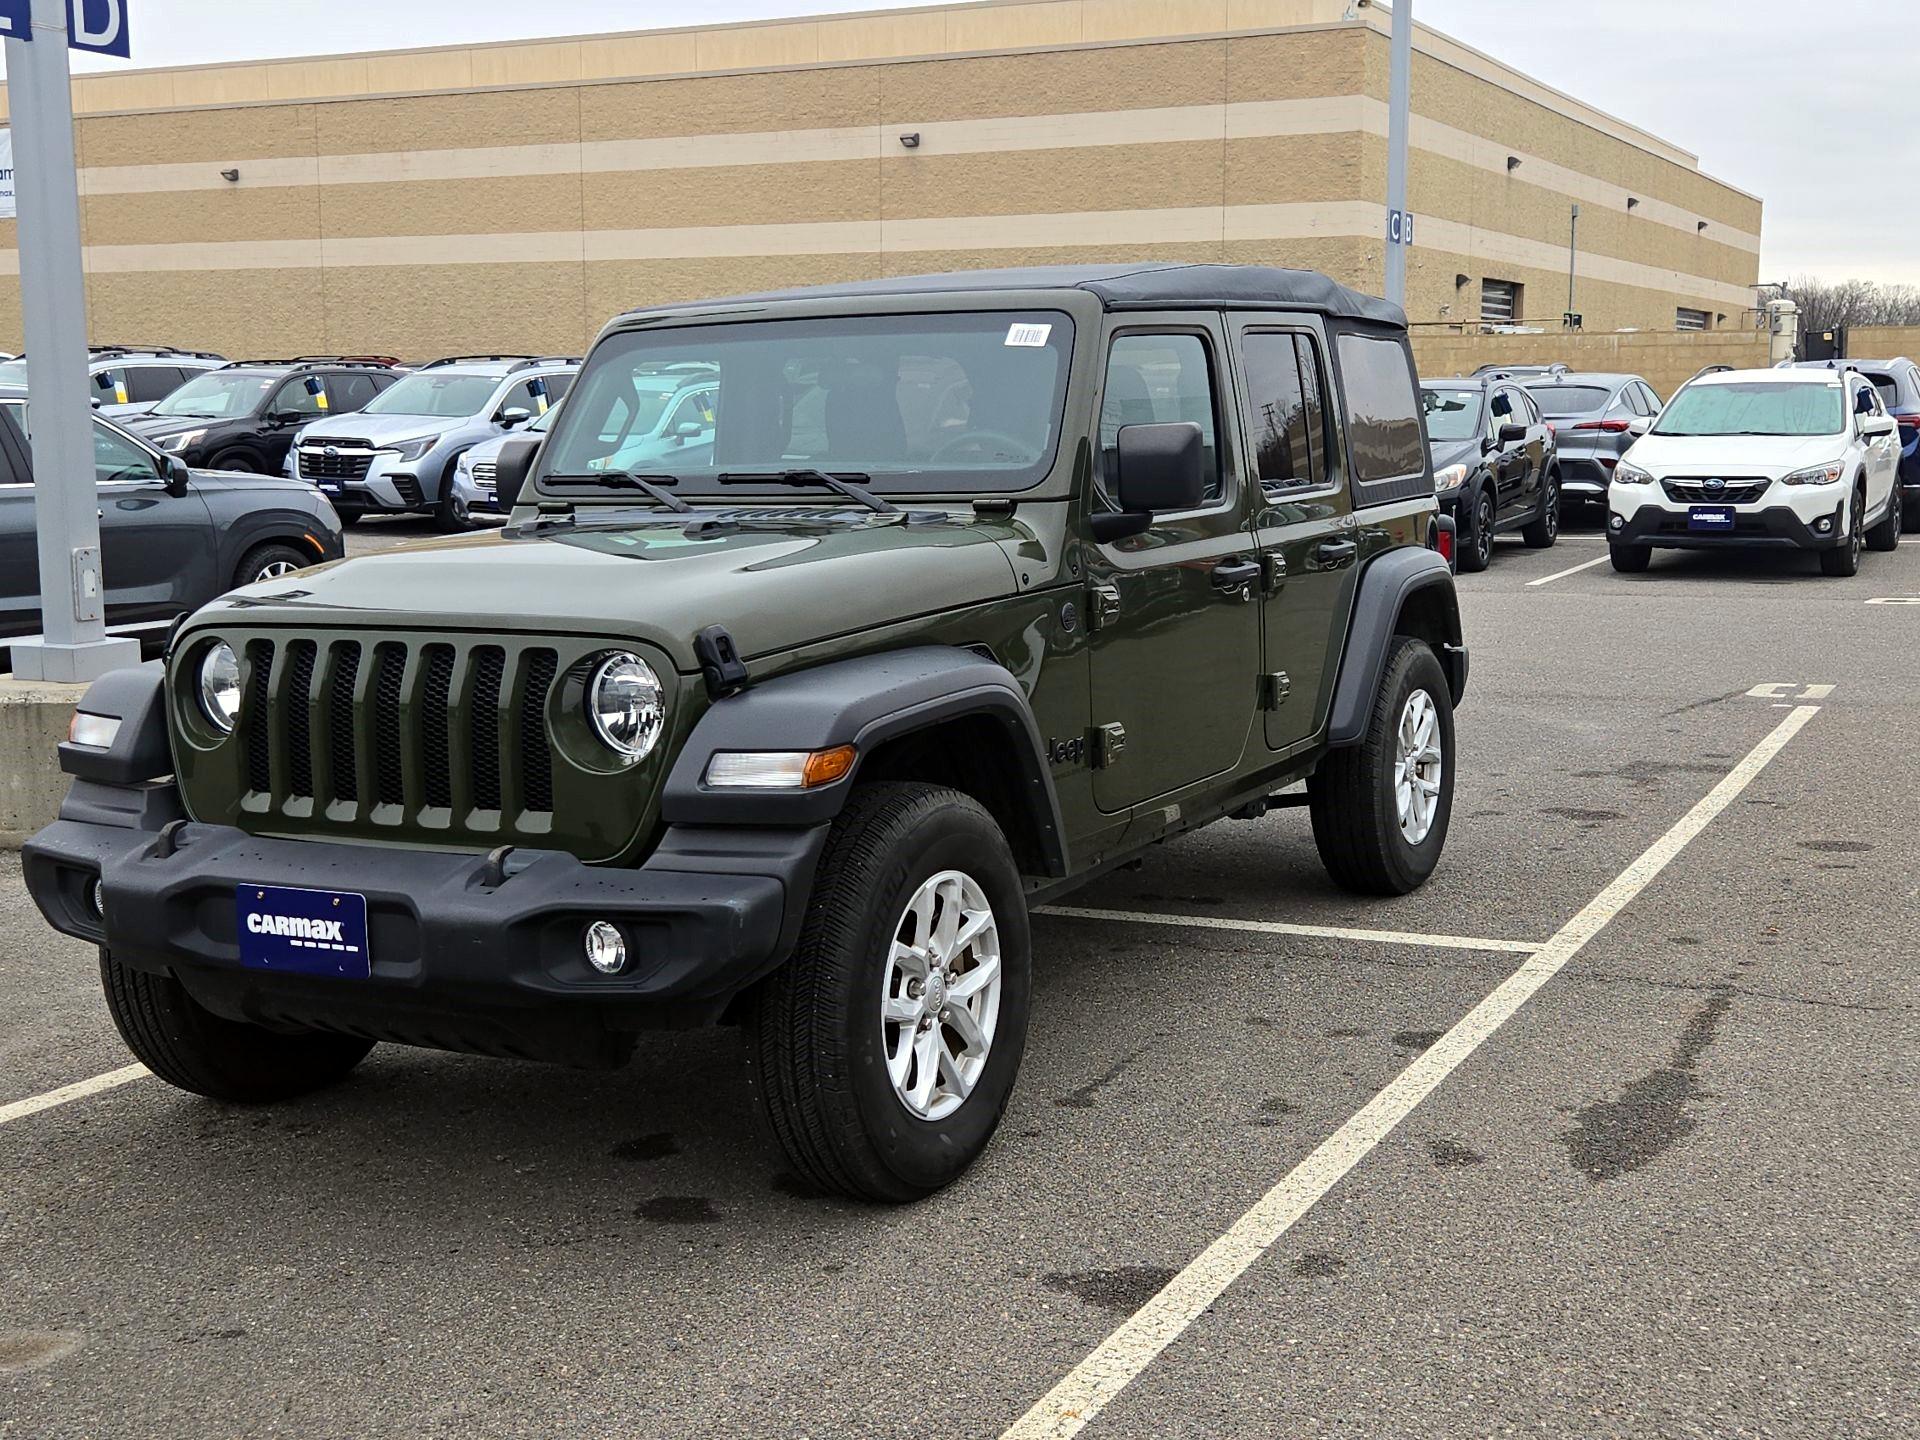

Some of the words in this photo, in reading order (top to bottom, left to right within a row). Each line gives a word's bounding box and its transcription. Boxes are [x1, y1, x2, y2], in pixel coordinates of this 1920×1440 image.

[73, 0, 120, 46] D
[1391, 213, 1400, 240] C
[1406, 216, 1412, 242] B
[1044, 736, 1084, 766] Jeep
